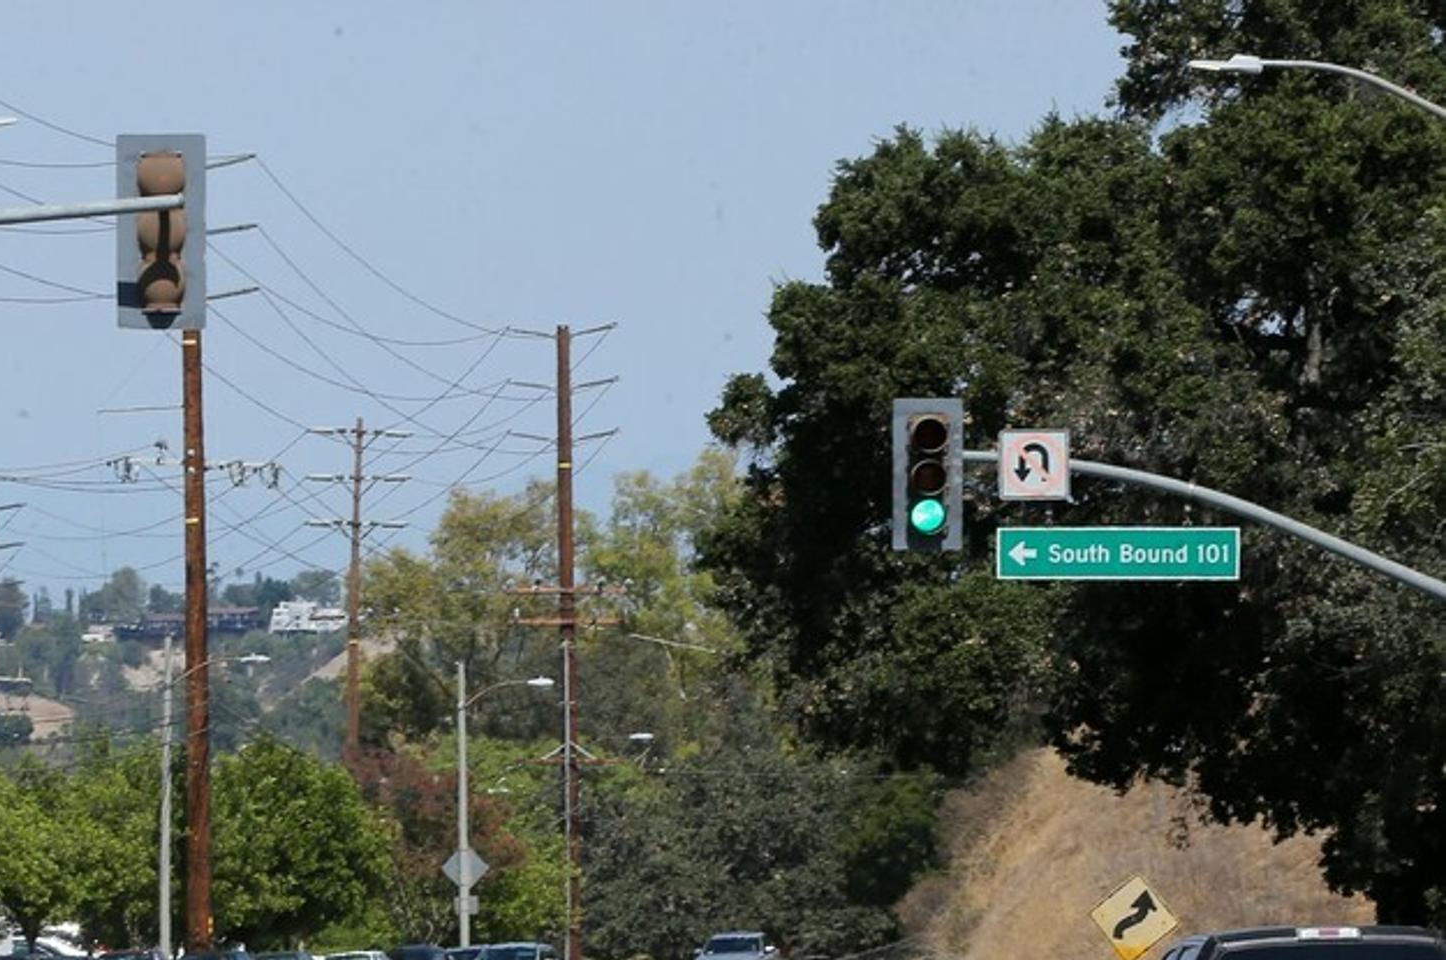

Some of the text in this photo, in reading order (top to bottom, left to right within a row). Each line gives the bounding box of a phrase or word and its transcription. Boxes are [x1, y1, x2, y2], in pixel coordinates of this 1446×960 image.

[1048, 543, 1230, 564] South Bound 101
